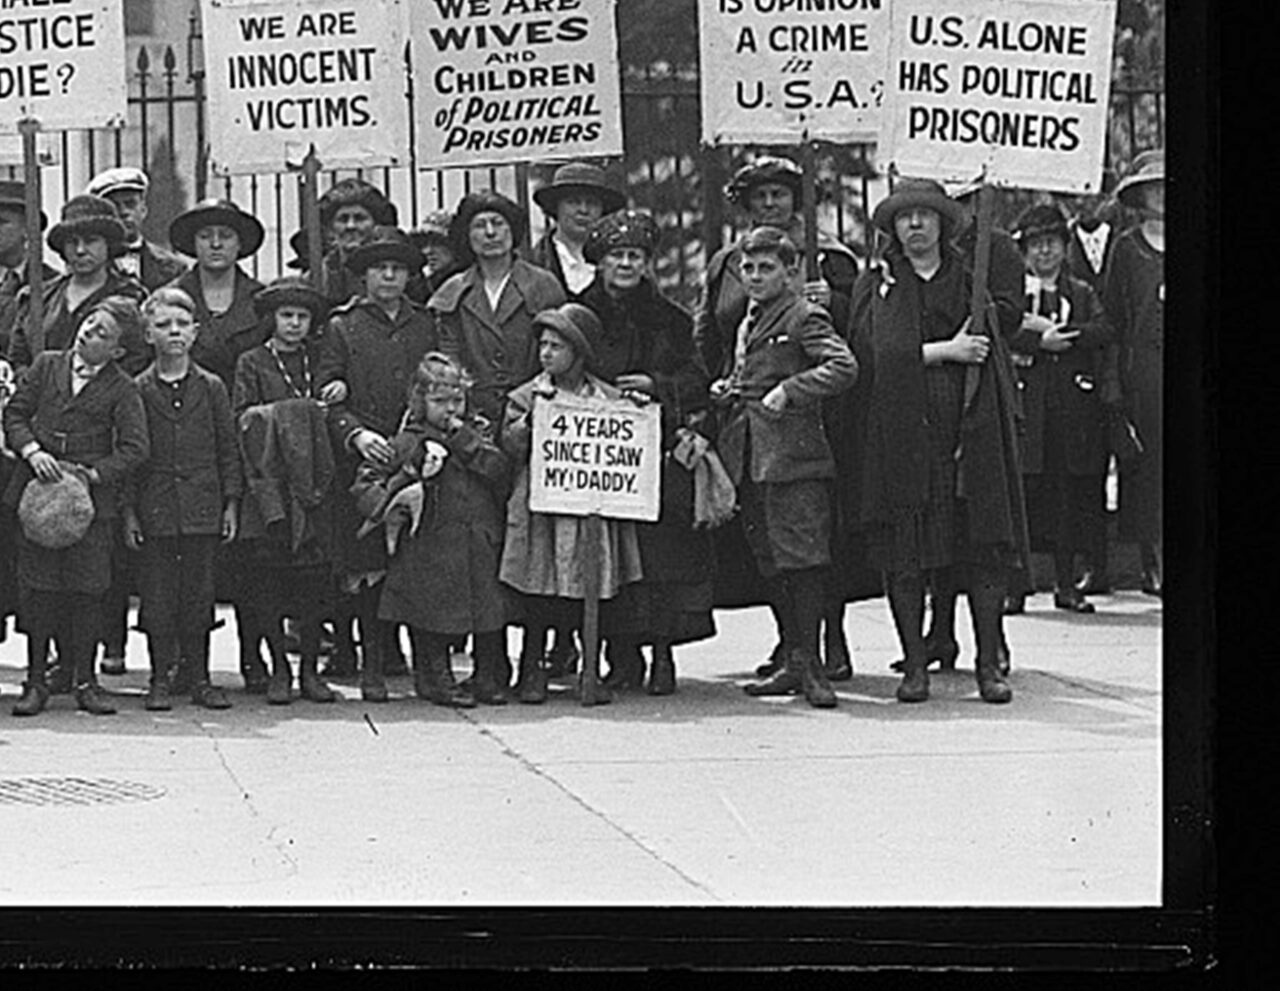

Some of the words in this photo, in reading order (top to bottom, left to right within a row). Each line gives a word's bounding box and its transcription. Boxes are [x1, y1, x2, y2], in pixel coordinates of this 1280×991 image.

[239, 15, 286, 42] WE
[296, 11, 357, 38] ARE
[428, 16, 589, 52] WIVES
[735, 26, 757, 54] A
[768, 23, 869, 53] CRIME
[910, 14, 970, 49] U.S.
[977, 20, 1087, 56] ALONE
[228, 47, 377, 89] INNOCENT
[433, 63, 596, 95] CHILDREN
[780, 59, 813, 74] in
[899, 60, 950, 94] HAS
[961, 65, 1098, 104] POLITICAL
[246, 94, 378, 132] VICTIMS.
[434, 98, 461, 132] of
[461, 94, 602, 126] POLITICAL
[908, 106, 1080, 152] PRISONERS
[442, 122, 602, 154] PRISONERS
[551, 414, 569, 437] 4
[573, 415, 634, 442] YEARS
[542, 439, 591, 464] SINCE
[594, 444, 601, 464] I
[604, 444, 644, 467] SAW
